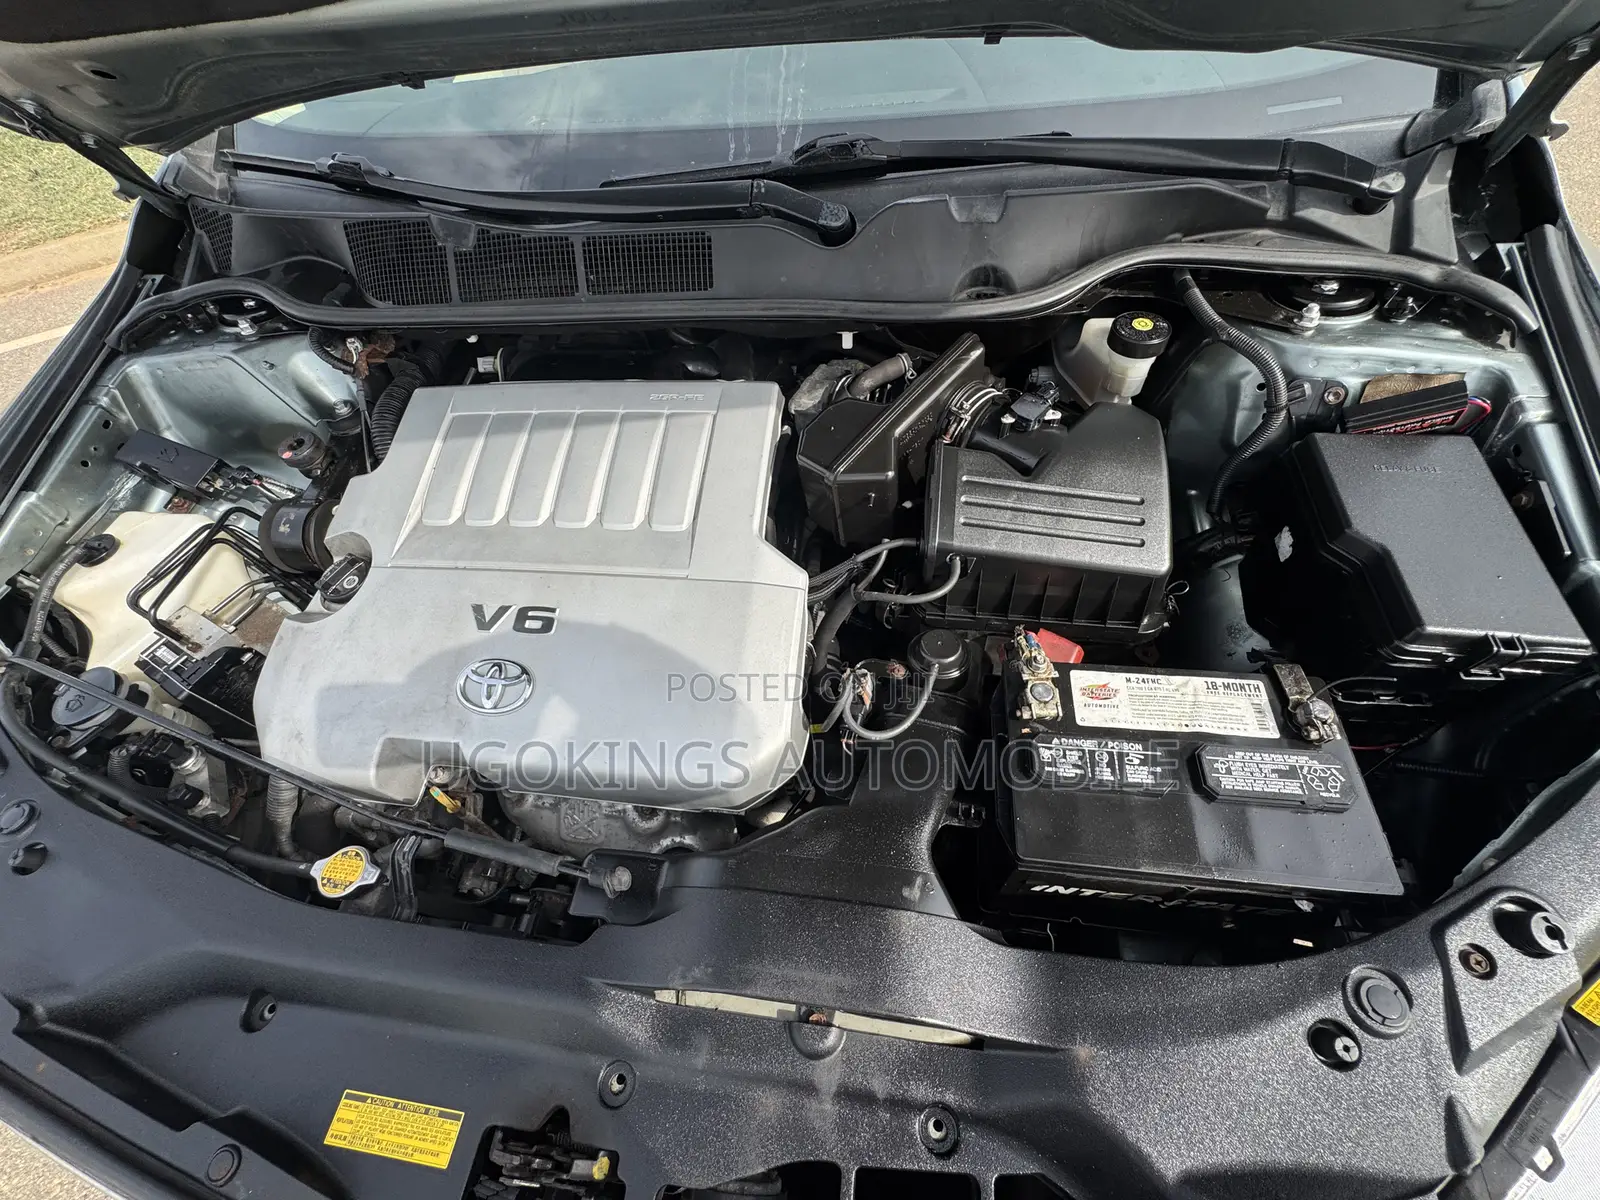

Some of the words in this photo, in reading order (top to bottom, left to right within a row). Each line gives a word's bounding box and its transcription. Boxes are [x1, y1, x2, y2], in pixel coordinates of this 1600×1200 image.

[470, 603, 560, 635] V6
[1203, 680, 1262, 694] 18-MONTH
[1060, 738, 1099, 748] DANGER
[1107, 741, 1143, 751] POISON
[1030, 884, 1299, 915] INTERSTATE
[372, 1097, 395, 1108] CAUTION
[397, 1101, 426, 1114] ATTENTION
